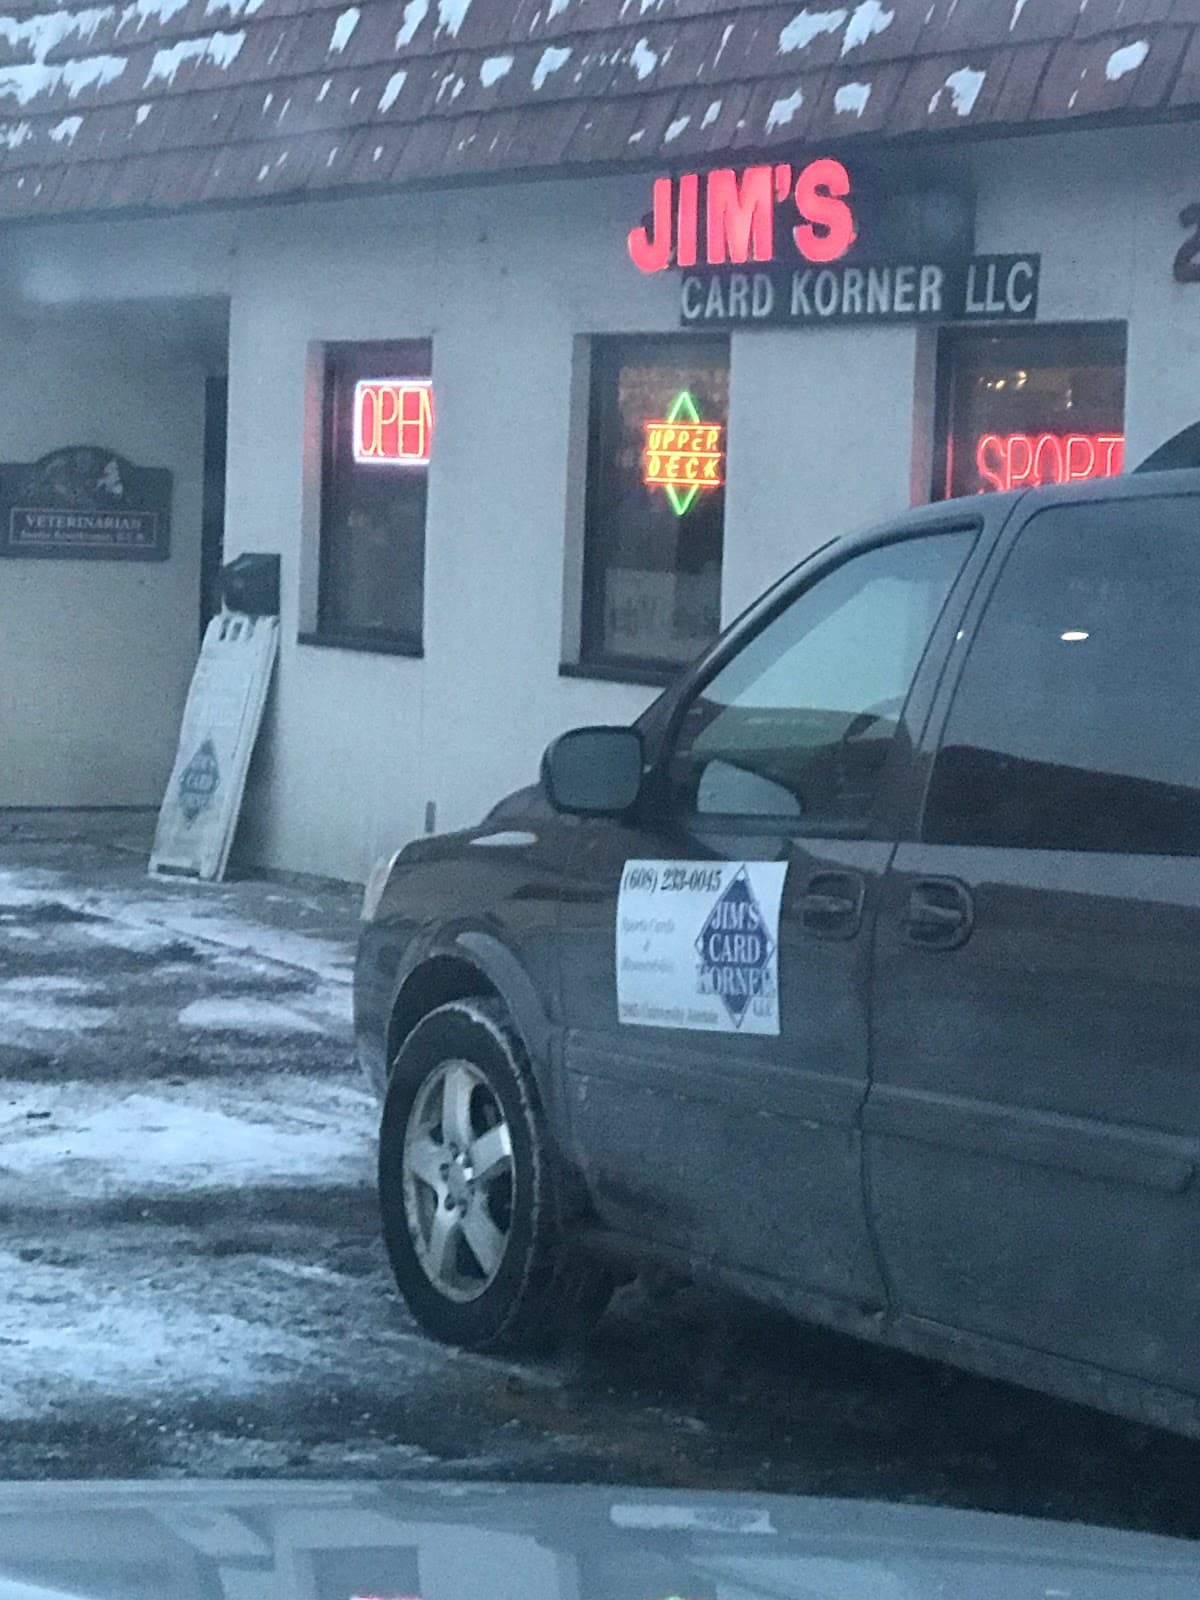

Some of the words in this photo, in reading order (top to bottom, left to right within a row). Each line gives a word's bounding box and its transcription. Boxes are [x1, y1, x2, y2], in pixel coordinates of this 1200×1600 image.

[627, 157, 857, 273] JIM'S
[681, 273, 775, 320] CARD
[790, 265, 943, 316] KORNER
[965, 261, 1034, 314] LLC
[648, 429, 719, 451] UPPER
[647, 454, 720, 479] DECK
[25, 514, 143, 529] VETERINARIAN
[709, 933, 761, 963] CARD
